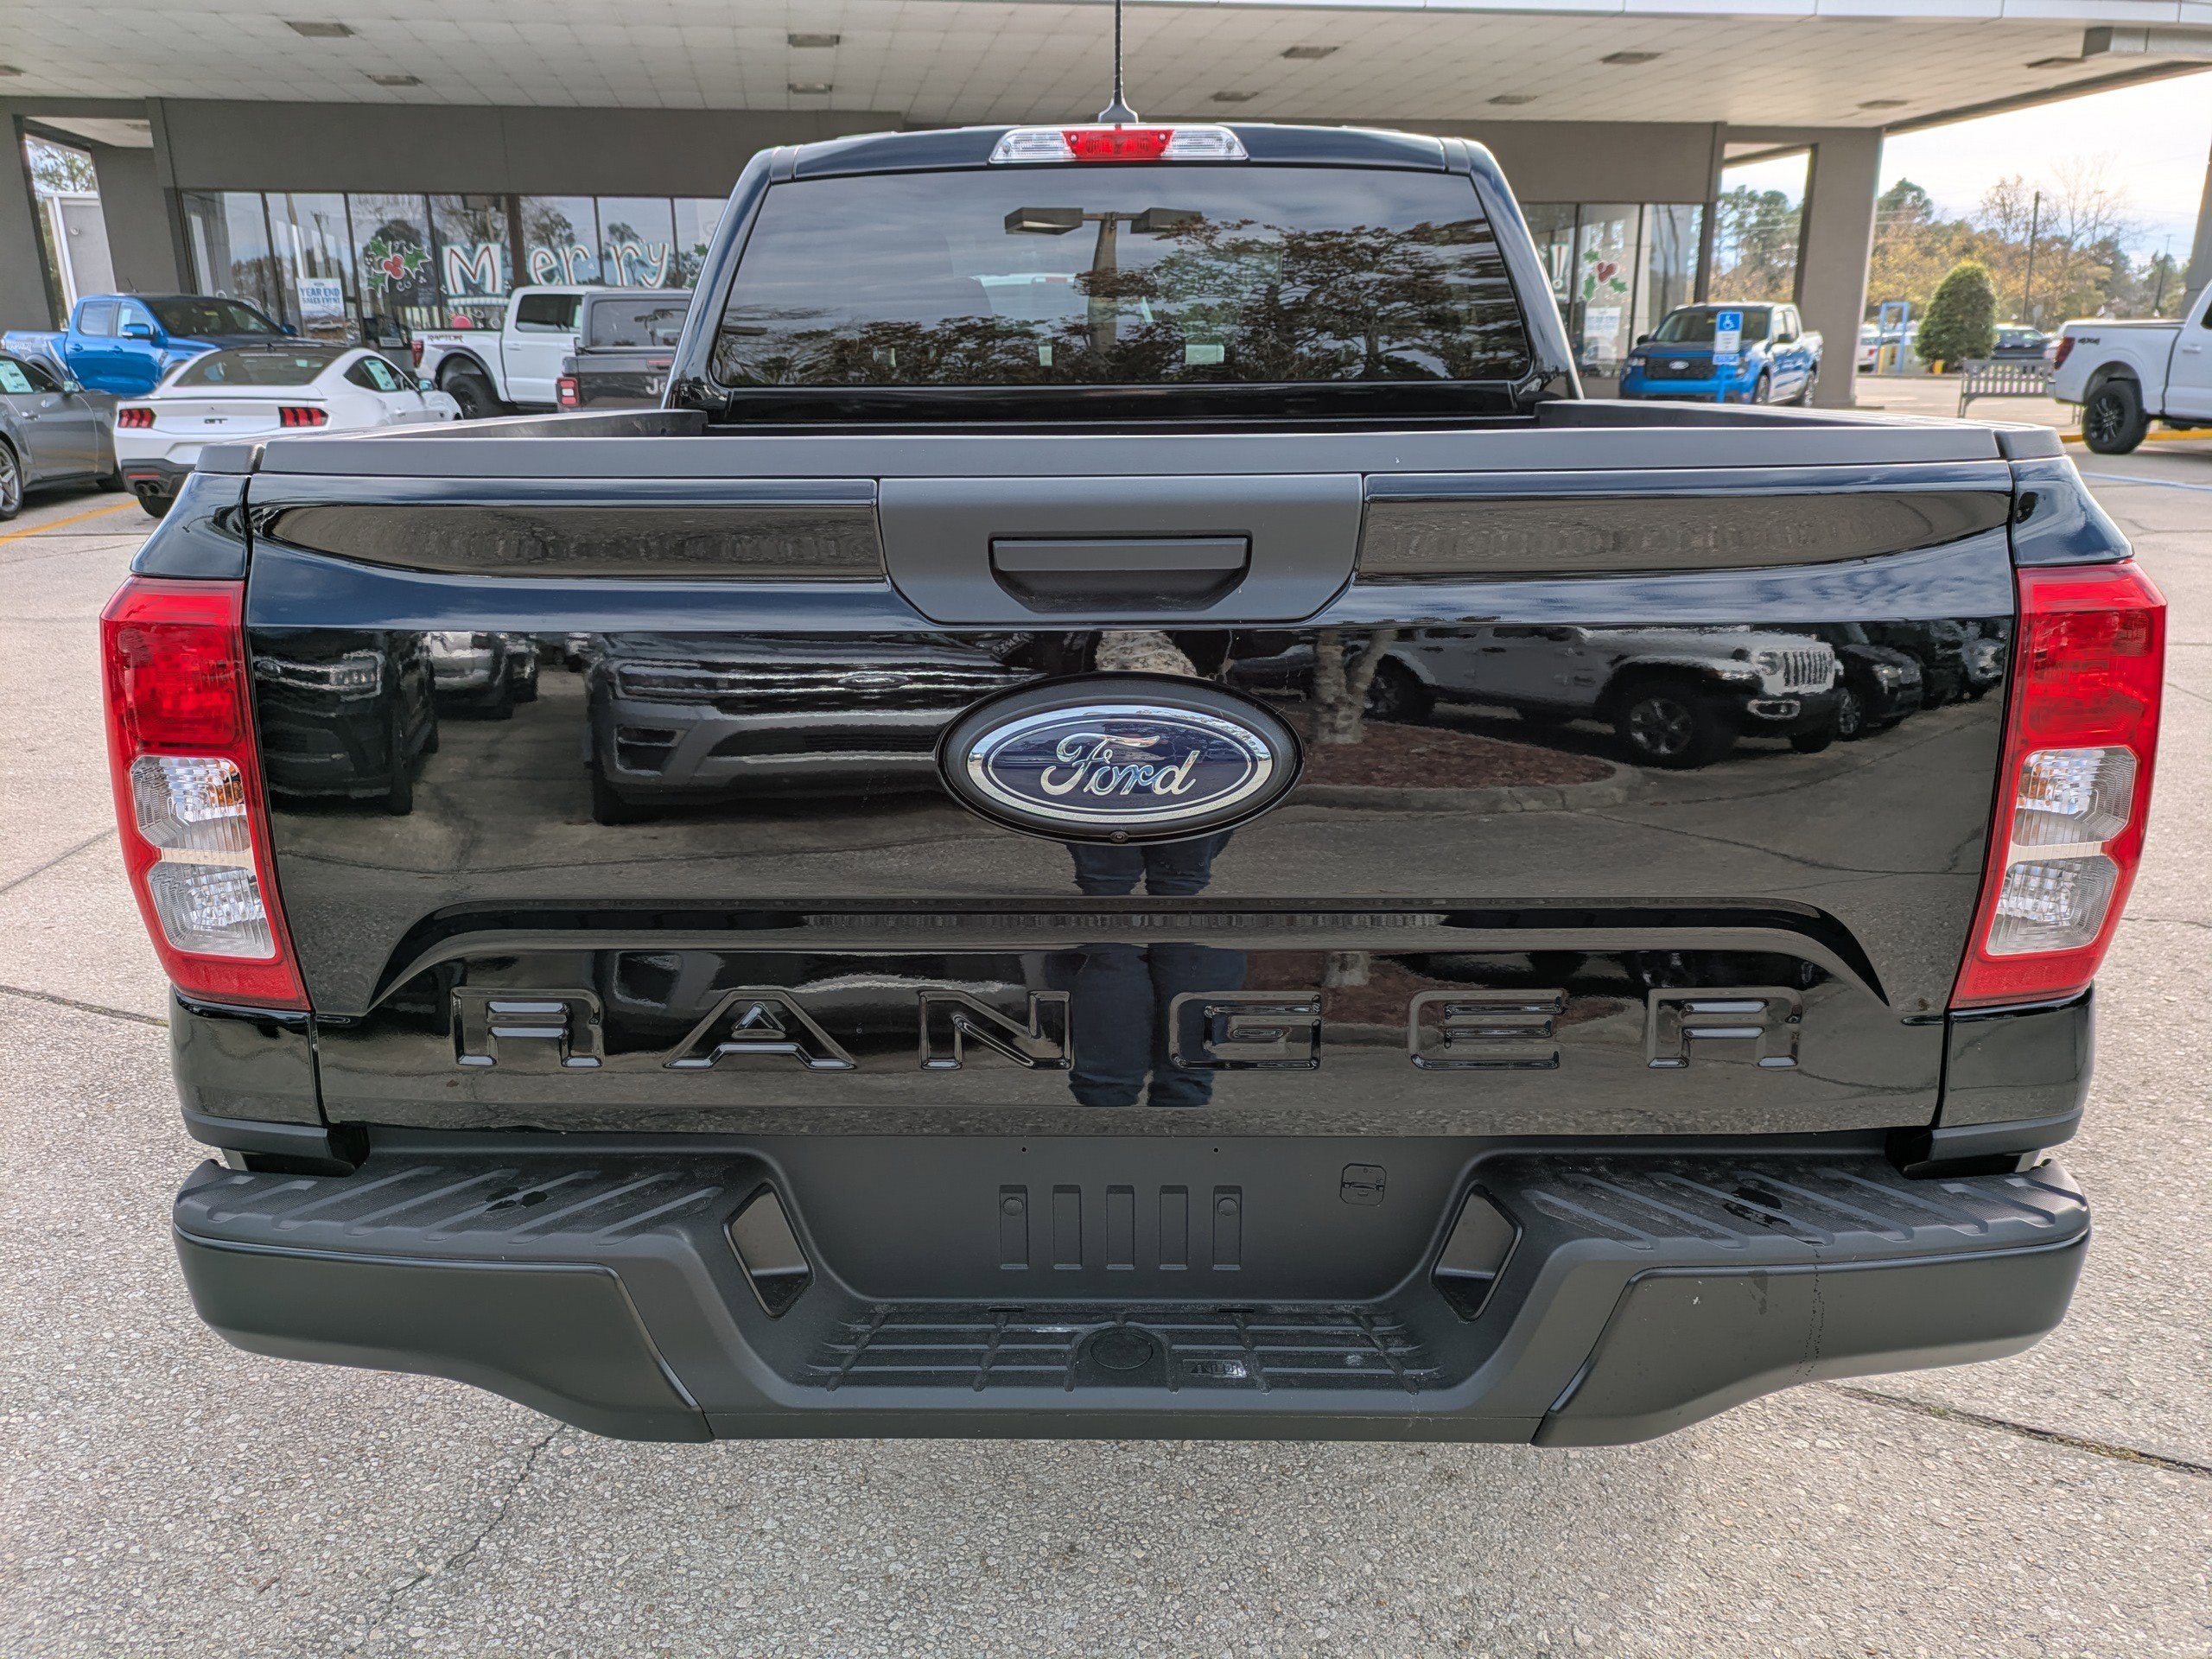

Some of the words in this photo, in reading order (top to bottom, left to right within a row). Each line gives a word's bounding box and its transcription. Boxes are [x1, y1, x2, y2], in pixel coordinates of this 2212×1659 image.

[300, 288, 322, 296] YEAR
[442, 242, 670, 296] Merry
[427, 334, 464, 343] RAPTOR
[1040, 732, 1200, 796] Ford
[449, 988, 1802, 1071] RANGER
